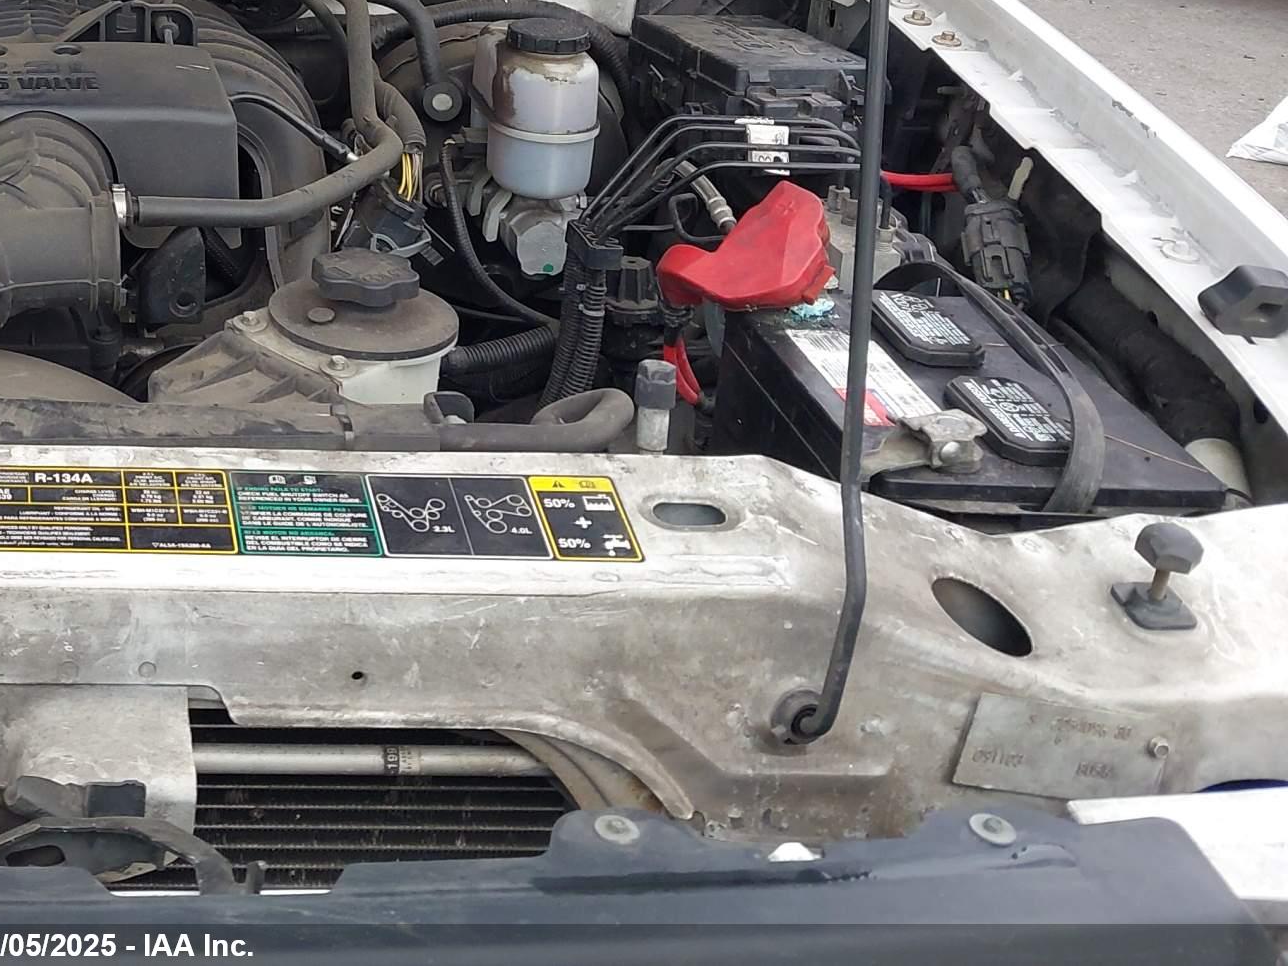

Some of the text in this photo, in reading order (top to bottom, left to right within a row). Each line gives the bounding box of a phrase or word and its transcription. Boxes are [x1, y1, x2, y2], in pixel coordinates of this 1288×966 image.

[17, 77, 100, 90] VALVE
[34, 472, 93, 483] R-134A
[543, 498, 575, 508] 50%
[558, 537, 591, 549] 50%
